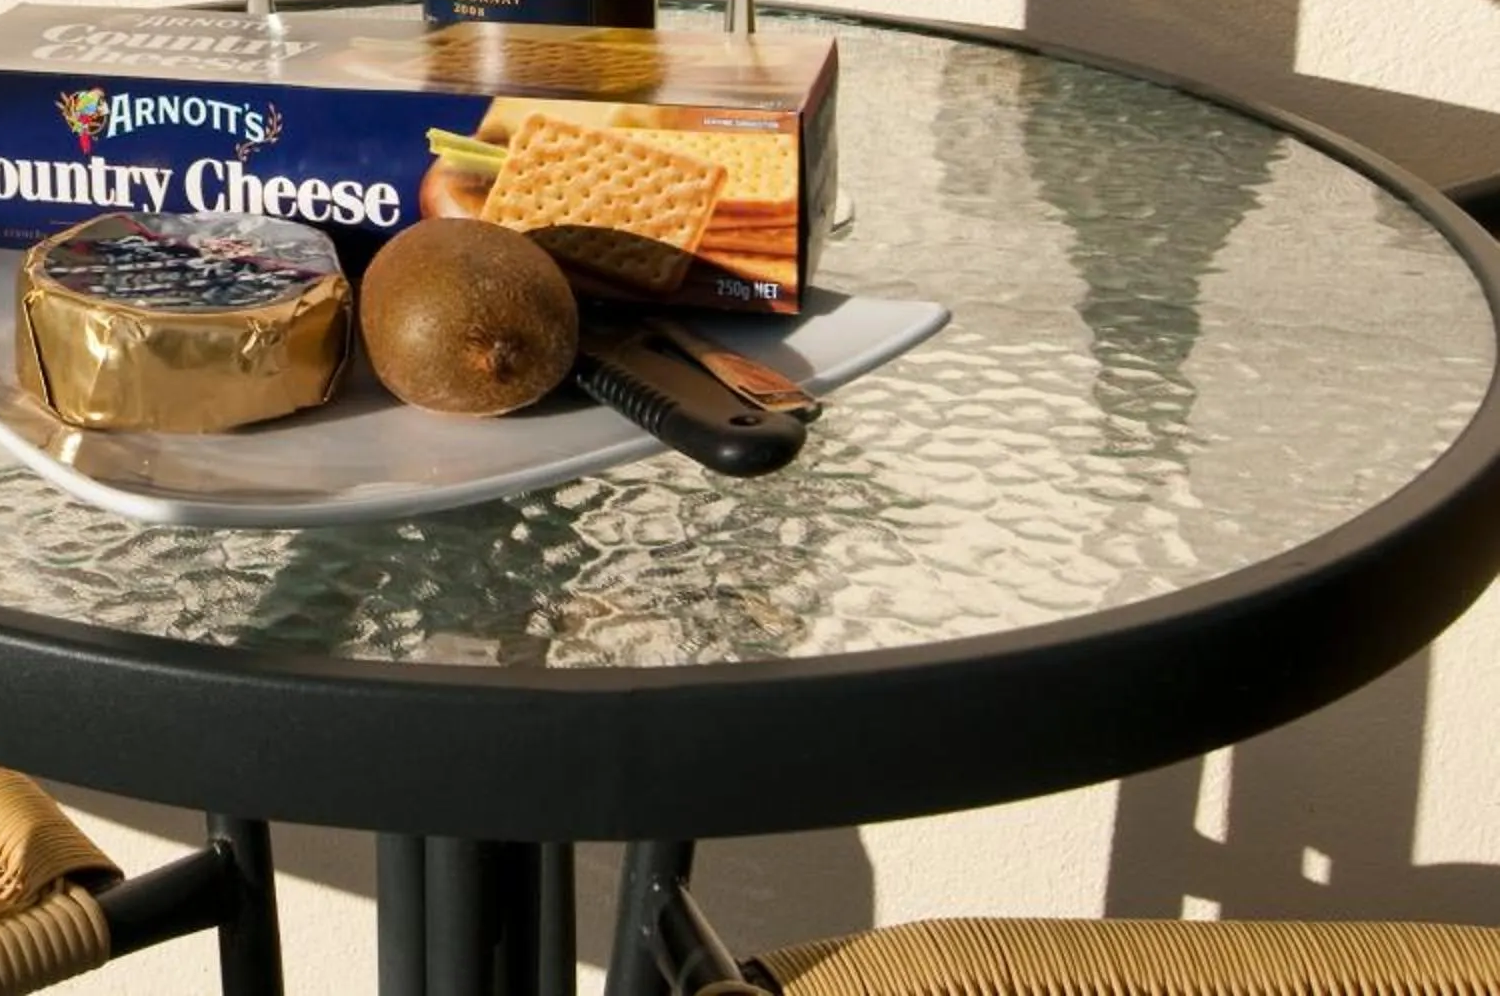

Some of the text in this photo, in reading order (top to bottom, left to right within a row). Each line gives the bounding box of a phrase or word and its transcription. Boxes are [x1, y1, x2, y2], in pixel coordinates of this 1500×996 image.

[31, 43, 276, 73] Cheese
[42, 22, 319, 62] Country
[106, 92, 266, 143] ARNOTT'S
[184, 157, 400, 228] Cheese
[716, 279, 779, 301] 250g NET
